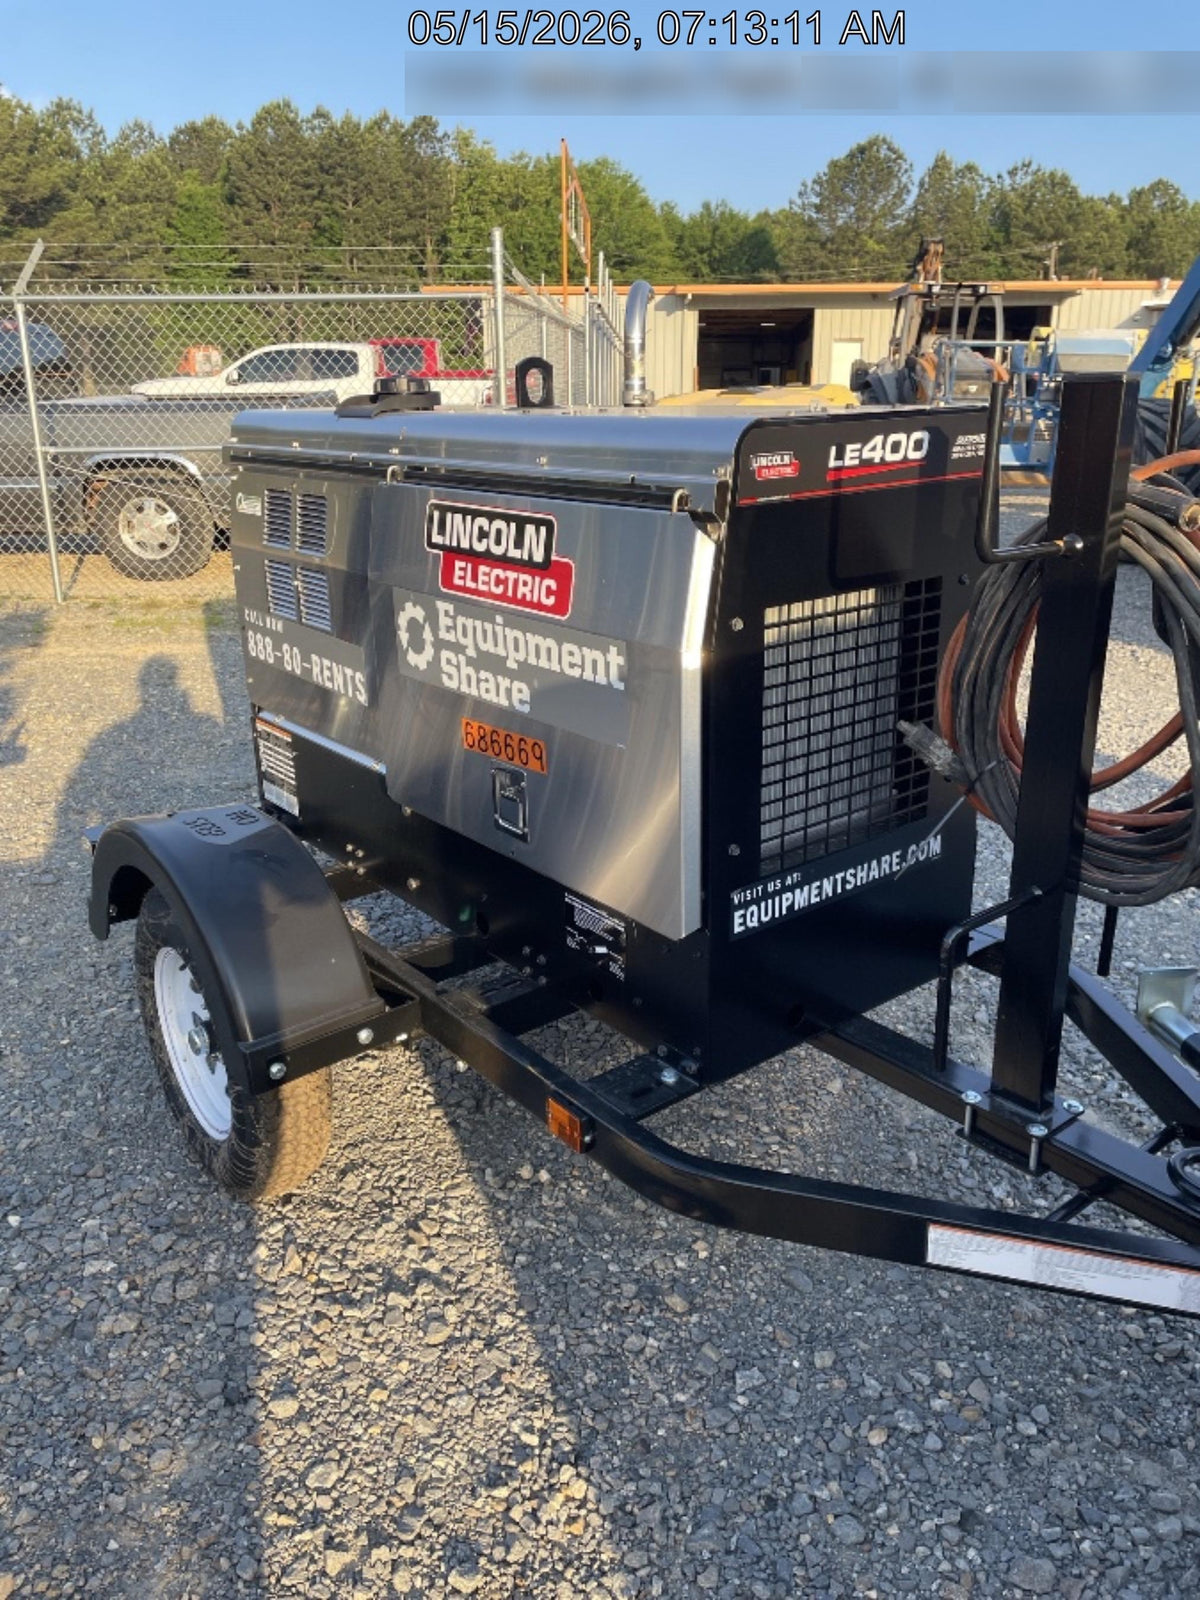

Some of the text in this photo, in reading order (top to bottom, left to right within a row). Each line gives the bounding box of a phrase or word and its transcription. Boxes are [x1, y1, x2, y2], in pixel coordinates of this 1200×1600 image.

[828, 430, 930, 468] LE400
[430, 508, 547, 563] LINCOLN
[452, 560, 557, 607] ELECTRIC
[247, 630, 368, 707] 888-80-RENTS
[437, 600, 626, 690] Equipment
[439, 650, 531, 713] Share
[465, 721, 545, 772] 686669
[732, 884, 764, 905] VISIT
[767, 879, 782, 893] US
[733, 834, 942, 934] EQUIPMENTSHARE.COM
